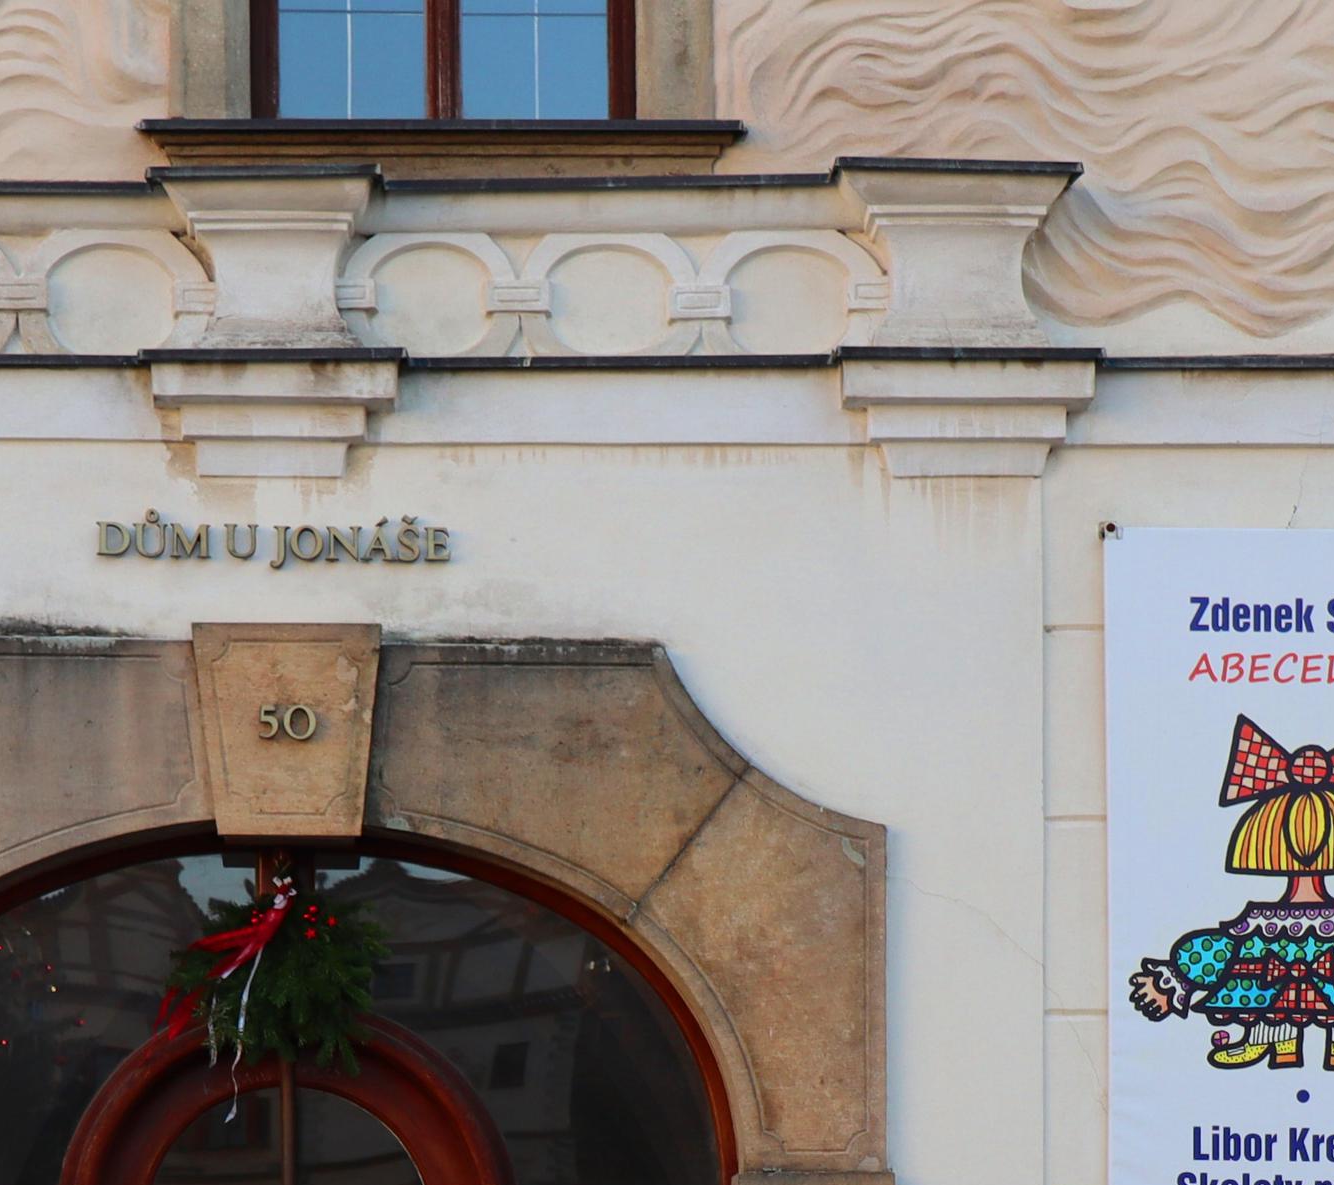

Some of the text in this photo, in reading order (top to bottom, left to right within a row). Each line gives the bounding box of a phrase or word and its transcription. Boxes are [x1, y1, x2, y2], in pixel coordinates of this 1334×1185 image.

[96, 508, 452, 570] DŮM U JONÁŠE
[1190, 596, 1315, 633] Zdenek
[258, 704, 317, 741] 50
[1193, 1126, 1278, 1161] Libor
